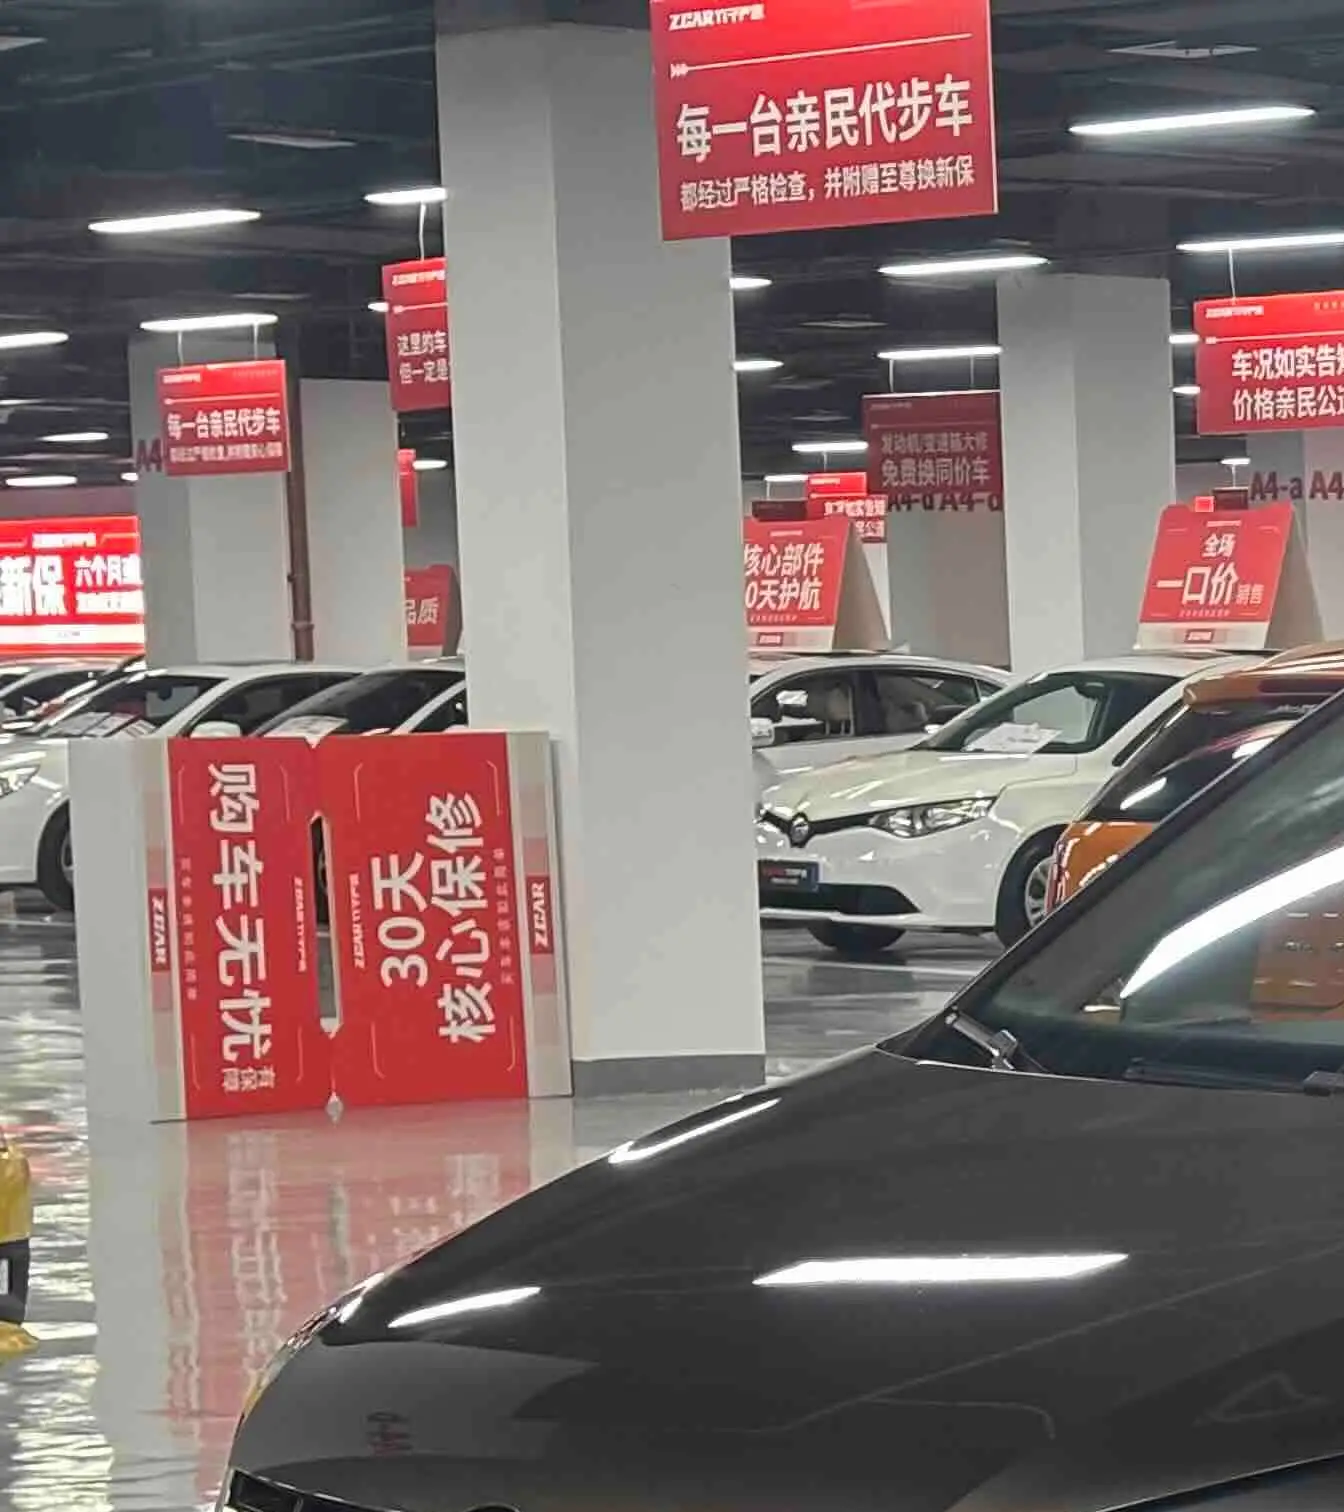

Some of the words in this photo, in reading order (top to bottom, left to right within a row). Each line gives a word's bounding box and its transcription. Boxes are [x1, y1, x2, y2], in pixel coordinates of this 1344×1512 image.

[677, 73, 973, 163] 每一台亲民代步车
[167, 407, 281, 441] 每一台亲民代步车
[881, 456, 991, 488] 免费换同价车
[1250, 471, 1303, 501] A4-a
[744, 542, 825, 577] 核心部件
[1201, 533, 1237, 558] 全场
[1156, 561, 1240, 606] 一口价
[152, 895, 171, 966] ZCAR
[208, 762, 273, 1063] 购车无忧
[371, 851, 428, 988] 30天
[426, 792, 496, 1044] 核心保修
[530, 880, 550, 949] ZCAR
[222, 1066, 275, 1093] 有保障
